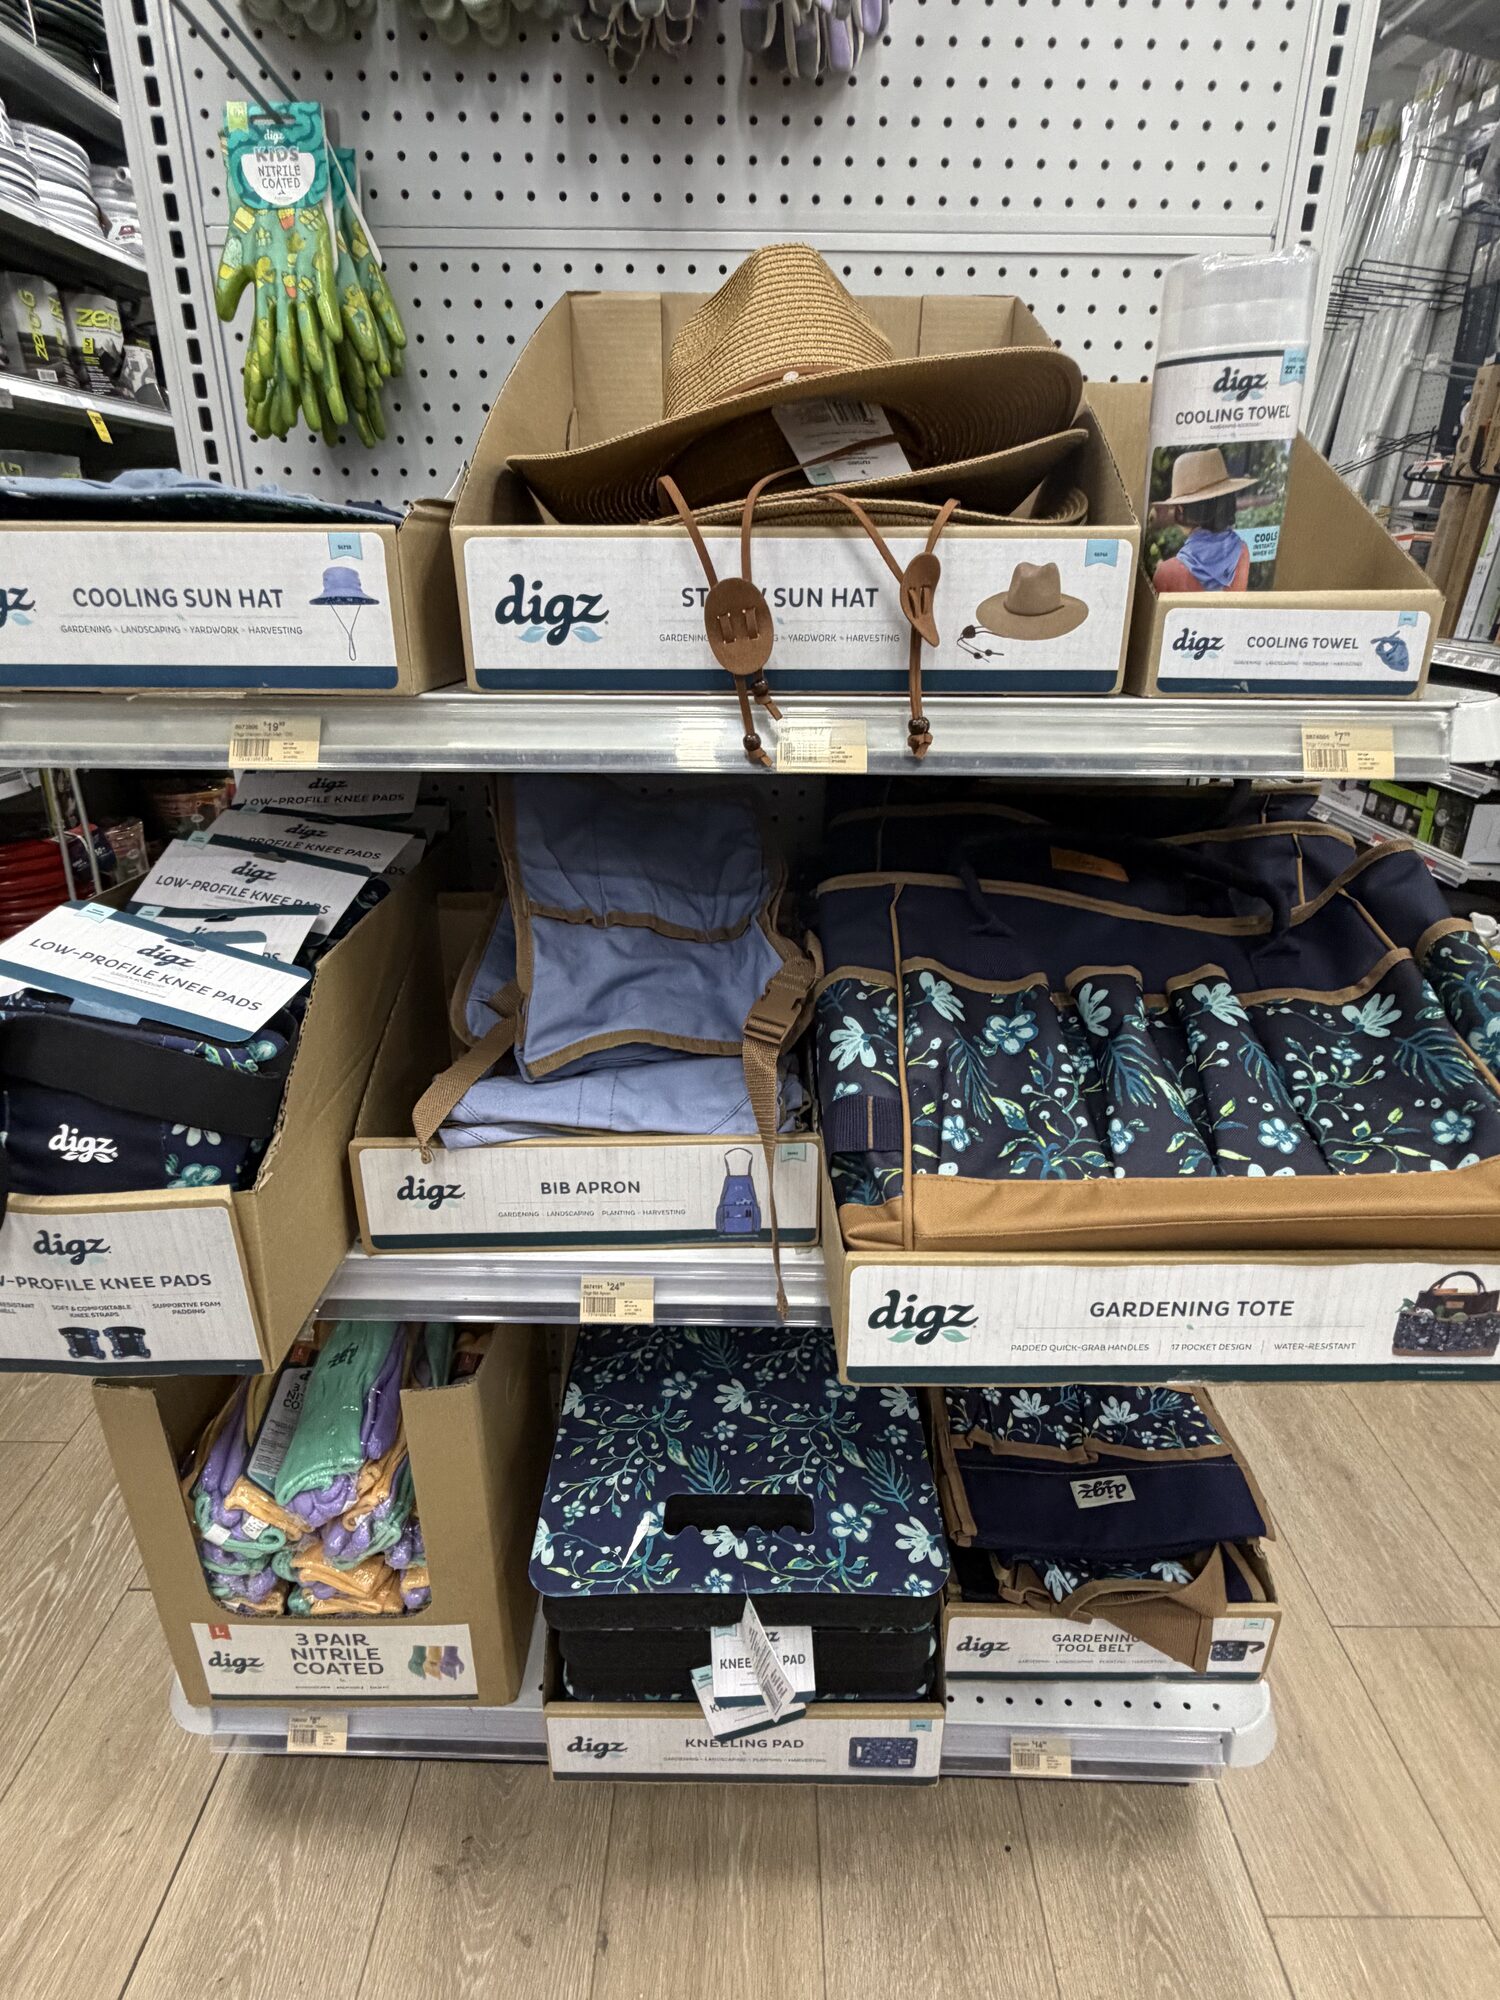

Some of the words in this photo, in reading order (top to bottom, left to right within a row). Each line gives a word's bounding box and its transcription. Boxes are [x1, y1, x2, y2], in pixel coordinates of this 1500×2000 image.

[254, 146, 300, 162] KIDS
[258, 165, 301, 177] NITRILE
[262, 178, 301, 189] COATED
[1213, 366, 1269, 402] digz
[1175, 407, 1244, 425] COOLING
[1248, 405, 1291, 420] TOWEL
[1254, 531, 1278, 543] COOLS
[72, 587, 178, 608] COOLING
[183, 588, 232, 608] SUN
[238, 588, 283, 608] HAT
[773, 587, 823, 608] SUN
[831, 587, 879, 608] HAT
[495, 573, 610, 646] digz
[60, 625, 112, 634] GARDENING
[120, 625, 181, 634] LANDSCAPING
[189, 626, 239, 635] YARDWORK
[248, 626, 303, 635] HARVESTING
[788, 634, 837, 642] YARDWORK
[846, 634, 900, 642] HARVESTING
[1172, 627, 1226, 661] digz
[1247, 636, 1308, 649] COOLING
[1312, 637, 1360, 650] TOWEL
[308, 778, 349, 793] digz
[335, 794, 367, 803] KNEE
[372, 793, 405, 802] PADS
[284, 824, 329, 840] digz
[305, 843, 343, 855] KNEE
[346, 848, 381, 860] PADS
[231, 860, 278, 884] digz
[155, 874, 250, 898] LOW-PROFILE
[250, 890, 292, 907] KNEE
[136, 944, 197, 968] digz
[29, 938, 155, 980] LOW-PROFILE
[158, 974, 212, 996] KNEE
[212, 990, 263, 1011] PADS
[48, 1123, 118, 1163] digz
[396, 1175, 466, 1210] digz
[541, 1182, 570, 1196] BIB
[576, 1180, 641, 1195] APRON
[33, 1229, 111, 1266] digz
[100, 1276, 156, 1290] KNEE
[160, 1273, 212, 1288] PADS
[152, 1302, 198, 1310] SUPPORTIVE
[1090, 1300, 1230, 1318] GARDENING
[1237, 1300, 1295, 1317] TOTE
[867, 1289, 979, 1345] digz
[1010, 1344, 1048, 1352] PADDED
[1049, 1343, 1106, 1353] QUICK-GRAB
[1107, 1343, 1150, 1352] HANDLES
[1181, 1343, 1217, 1351] POCKET
[1218, 1343, 1252, 1351] DESIGN
[1273, 1342, 1356, 1351] WATER-RESISTANT
[1077, 1480, 1127, 1499] digz
[215, 1627, 225, 1636] L
[295, 1633, 309, 1646] 3
[315, 1633, 370, 1646] PAIR
[291, 1647, 381, 1661] NITRILE
[956, 1635, 1010, 1658] digz
[1056, 1643, 1095, 1653] TOOL
[1098, 1643, 1134, 1653] BELT
[208, 1651, 264, 1674] digz
[783, 1653, 806, 1666] PAD
[293, 1662, 384, 1675] COATED
[567, 1735, 628, 1759] digz
[685, 1738, 768, 1748] KNEELING
[772, 1739, 804, 1748] PAD
